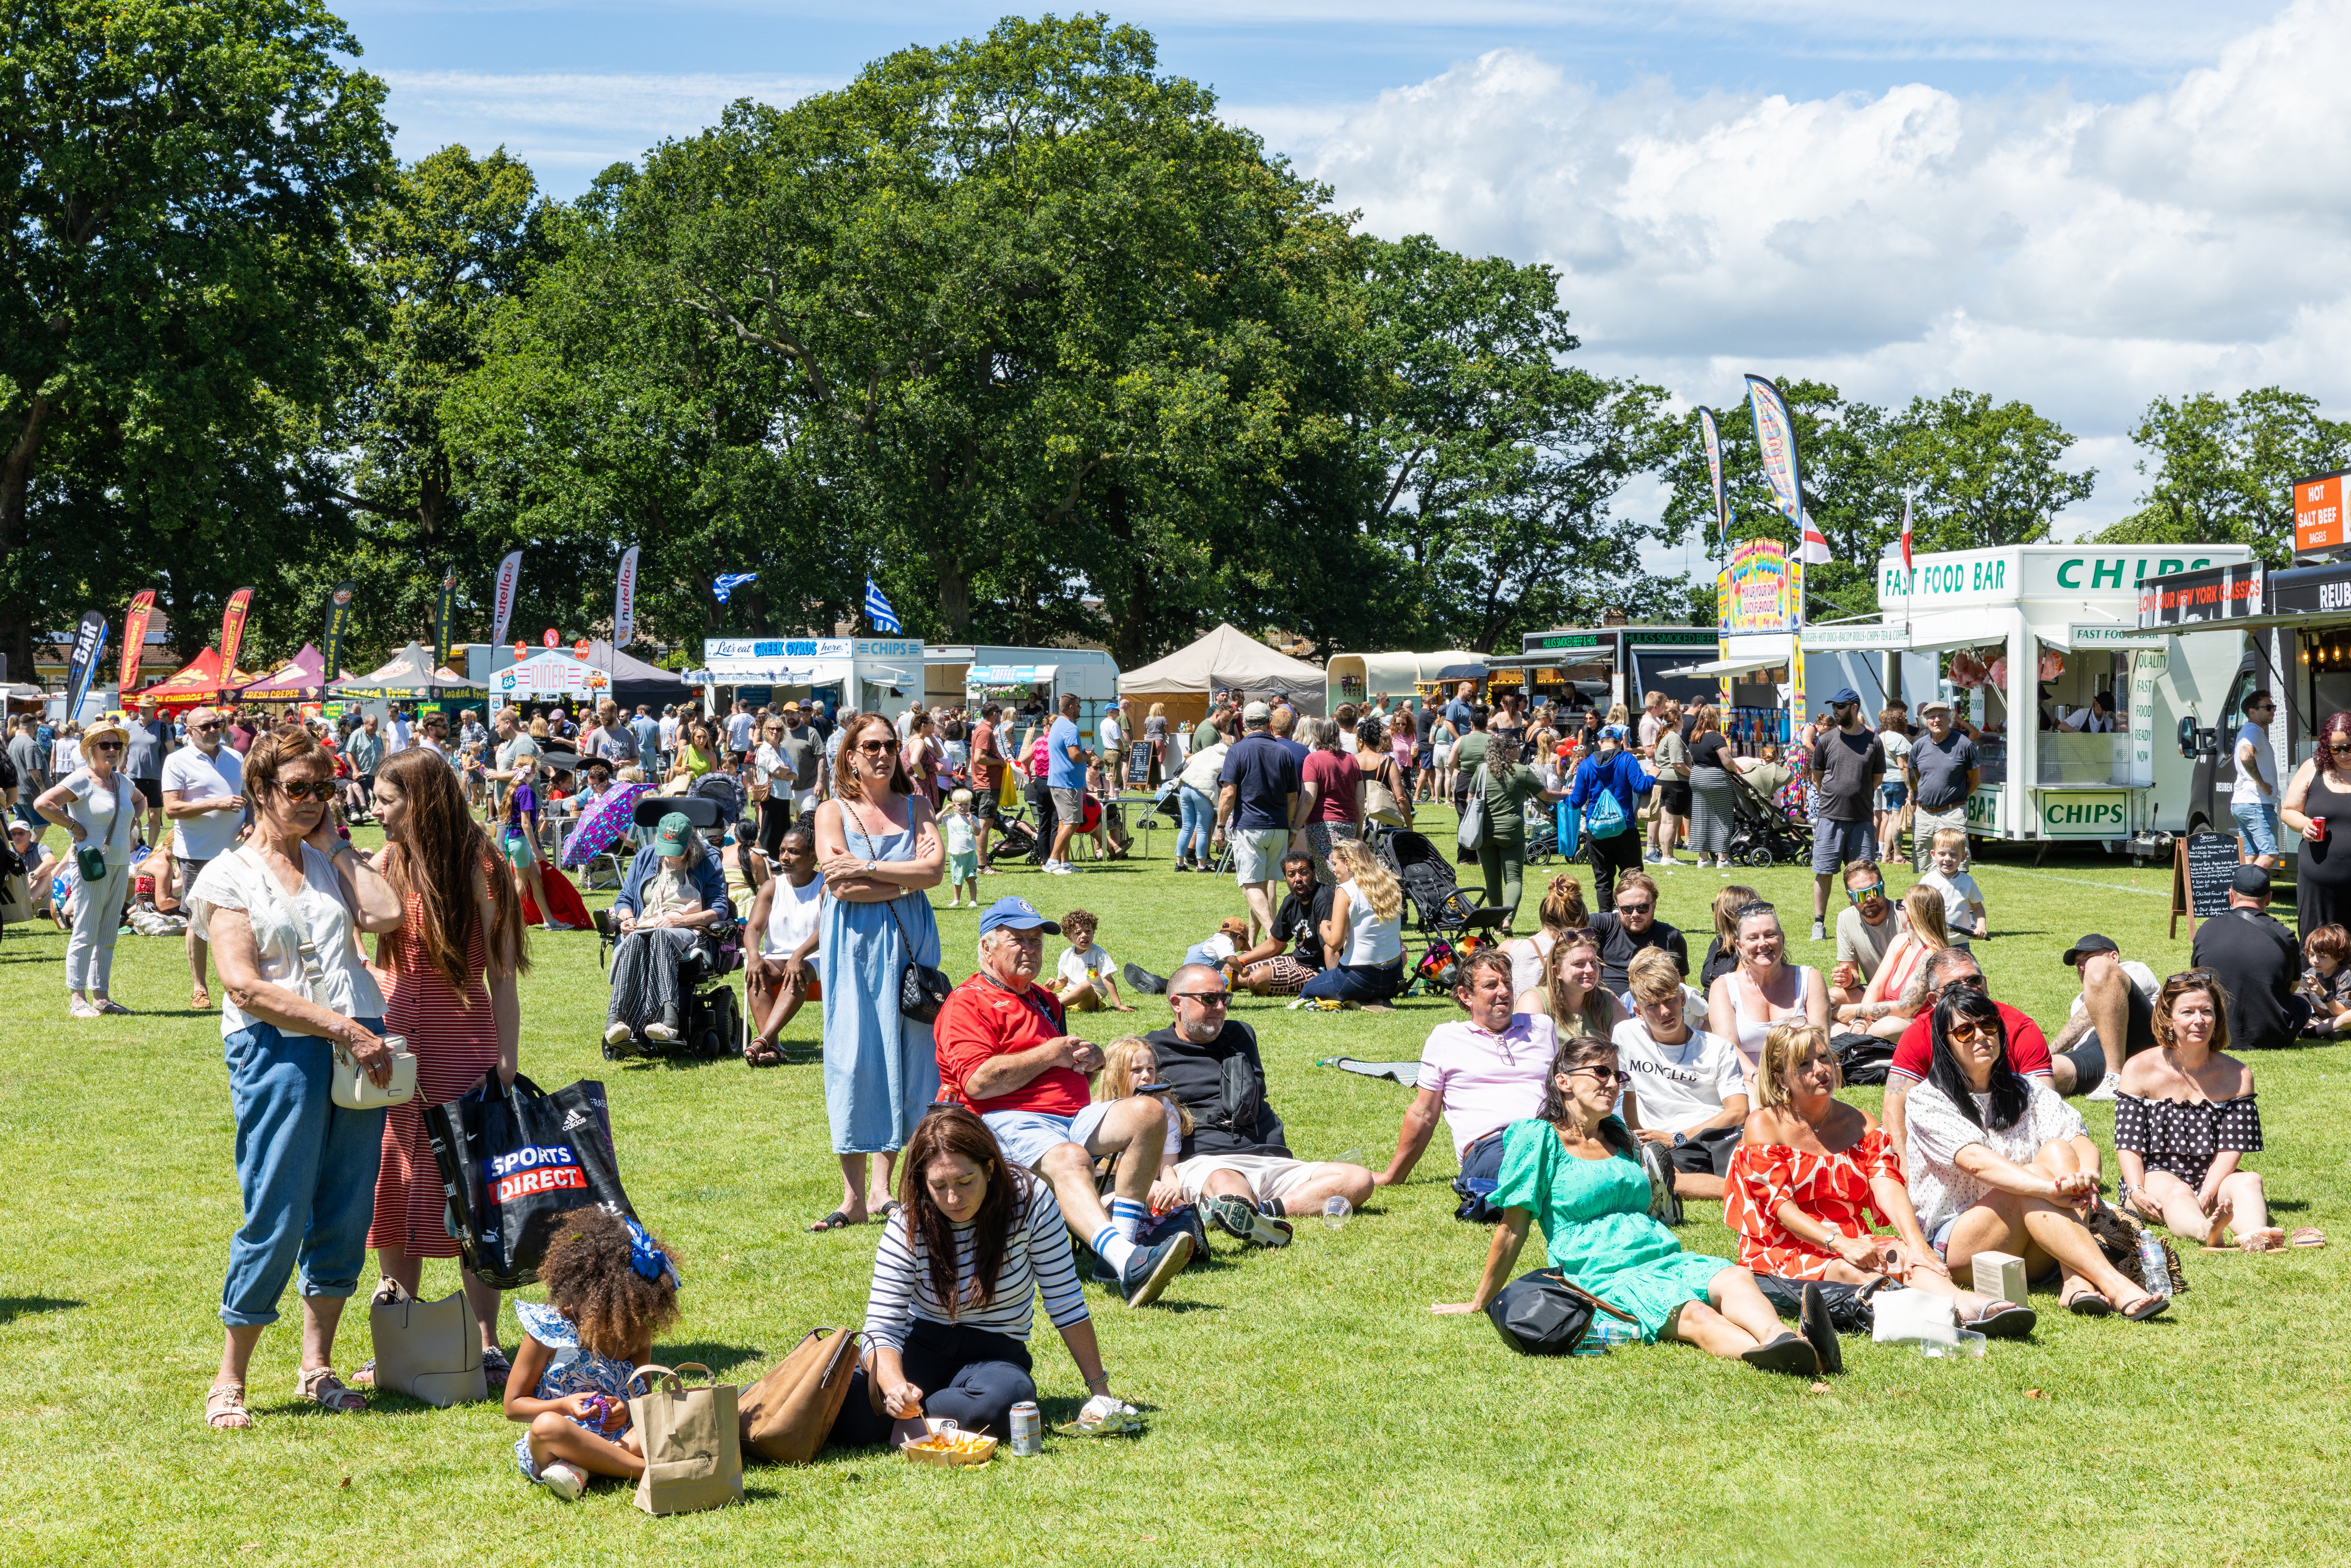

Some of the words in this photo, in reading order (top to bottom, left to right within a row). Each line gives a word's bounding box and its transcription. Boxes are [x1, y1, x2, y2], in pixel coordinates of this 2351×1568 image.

[2308, 485, 2324, 502] HOT
[2298, 510, 2316, 528] SALT
[2318, 506, 2336, 525] BEEF
[2309, 531, 2327, 544] BAGELS
[1733, 538, 1753, 583] JUST
[1755, 537, 1784, 575] SLUSH
[1924, 564, 1964, 594] FOOD
[1973, 559, 2005, 591] BAR
[497, 573, 512, 623] nutella
[620, 569, 631, 621] nutella
[1750, 585, 1755, 598] UP
[1756, 584, 1767, 598] YOUR
[1767, 583, 1777, 595] OWN
[2139, 595, 2157, 613] LOVE
[2159, 591, 2175, 610] OUR
[2177, 589, 2193, 607] NEW
[2195, 585, 2217, 605] YORK
[2219, 579, 2260, 600] CLASSICS
[1744, 601, 1754, 616] JUICY
[1755, 600, 1775, 613] FLAVOURS!
[127, 620, 140, 656] CHURROS
[225, 619, 237, 656] CHURROS
[1543, 638, 1556, 648] HULKS
[1556, 637, 1573, 647] SMOKED
[1573, 636, 1583, 646] BEEF
[1583, 637, 1586, 646] &
[1587, 636, 1597, 646] HOG
[1625, 633, 1655, 644] HULKS
[1657, 633, 1695, 643] SMOKED
[1696, 633, 1717, 644] BEEF
[1801, 633, 1817, 642] BURGERS
[1827, 632, 1837, 641] DOGS
[1839, 631, 1852, 641] BACON
[1853, 631, 1864, 641] ROLLS
[1867, 630, 1878, 641] CHIPS
[1893, 630, 1908, 640] COFFEE
[2077, 630, 2101, 638] FAST
[72, 621, 98, 665] BAR
[325, 639, 336, 679] Loaded
[331, 608, 343, 635] Fries
[438, 625, 448, 666] Loaded
[713, 641, 735, 656] Let's
[753, 641, 784, 657] GREEK
[785, 641, 817, 656] GYROS
[821, 643, 843, 651] here.
[871, 642, 906, 655] CHIPS
[2139, 654, 2168, 669] QUALITY
[124, 658, 132, 683] FRESH
[220, 658, 231, 682] FRESH
[531, 664, 566, 688] DINER
[991, 669, 1016, 680] COFFEE
[243, 691, 269, 699] FRESH
[270, 689, 300, 698] CREPES
[342, 687, 382, 698] Loaded
[386, 687, 411, 699] Fries
[442, 687, 470, 699] Loaded
[472, 687, 489, 700] Fries
[2137, 680, 2152, 693] FAST
[1971, 699, 1983, 710] FOOD
[2136, 705, 2152, 717] FOOD
[2135, 729, 2152, 741] READY
[605, 740, 629, 749] VENOM
[2137, 750, 2149, 762] NOW
[2216, 782, 2233, 792] REUBEN
[1968, 795, 1996, 824] BAR
[2047, 804, 2123, 824] CHIPS
[562, 1116, 587, 1131] adidas
[491, 1145, 572, 1177] SPORTS
[497, 1168, 577, 1201] DIRECT
